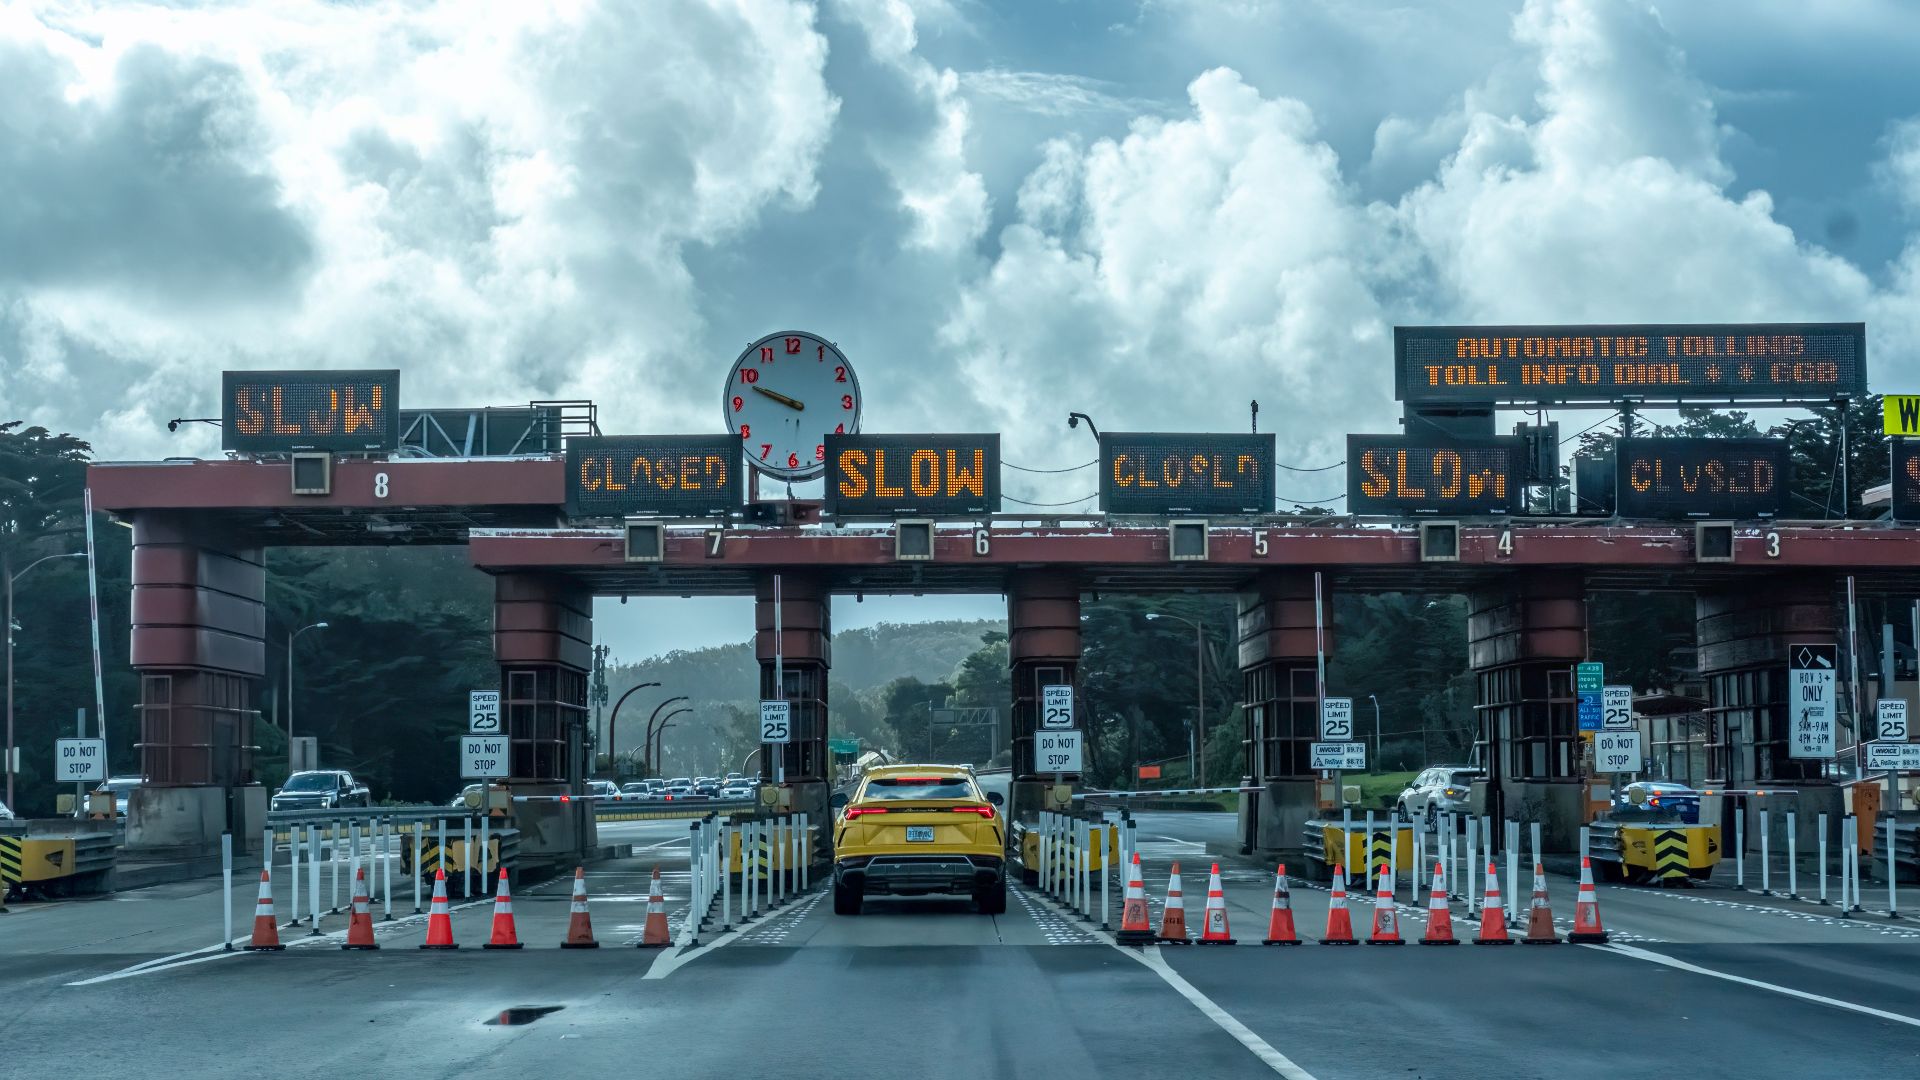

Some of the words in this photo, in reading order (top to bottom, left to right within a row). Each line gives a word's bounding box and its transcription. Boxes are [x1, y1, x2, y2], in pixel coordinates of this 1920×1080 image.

[785, 338, 801, 354] 12
[817, 345, 824, 361] 1
[1457, 336, 1648, 357] AUTOMATIC
[1663, 335, 1804, 356] TOLLING
[760, 347, 773, 363] 11
[740, 368, 759, 384] 10
[835, 366, 846, 382] 2
[1424, 365, 1508, 385] TOLL
[1521, 364, 1600, 385] INFO
[1614, 363, 1689, 384] DIAL
[733, 396, 744, 412] 9
[842, 395, 853, 410] 3
[740, 424, 750, 439] 8
[835, 423, 844, 434] 4
[761, 444, 772, 460] 7
[816, 445, 824, 460] 5
[788, 453, 799, 469] 6
[839, 449, 983, 497] SLOW
[374, 472, 389, 498] 8
[708, 531, 722, 555] 7
[975, 529, 989, 555] 6
[1255, 530, 1268, 556] 5
[1498, 530, 1514, 555] 4
[1766, 532, 1780, 557] 3
[1799, 672, 1814, 683] HOV
[472, 694, 498, 702] SPEED
[1802, 685, 1823, 702] ONLY
[474, 703, 495, 711] LIMIT
[473, 712, 498, 729] 25
[1046, 707, 1071, 724] 25
[1605, 708, 1630, 725] 25
[763, 722, 788, 739] 25
[1325, 720, 1349, 736] 25
[1880, 721, 1905, 737] 25
[63, 746, 76, 757] DO
[80, 746, 96, 757] NOT
[468, 743, 480, 754] DO
[485, 743, 501, 754] NOT
[1042, 738, 1054, 749] DO
[1058, 738, 1075, 749] NOT
[1601, 739, 1614, 750] DO
[1617, 738, 1634, 749] NOT
[474, 759, 496, 770] STOP
[1048, 754, 1070, 765] STOP
[1607, 754, 1629, 765] STOP
[69, 763, 92, 774] STOP
